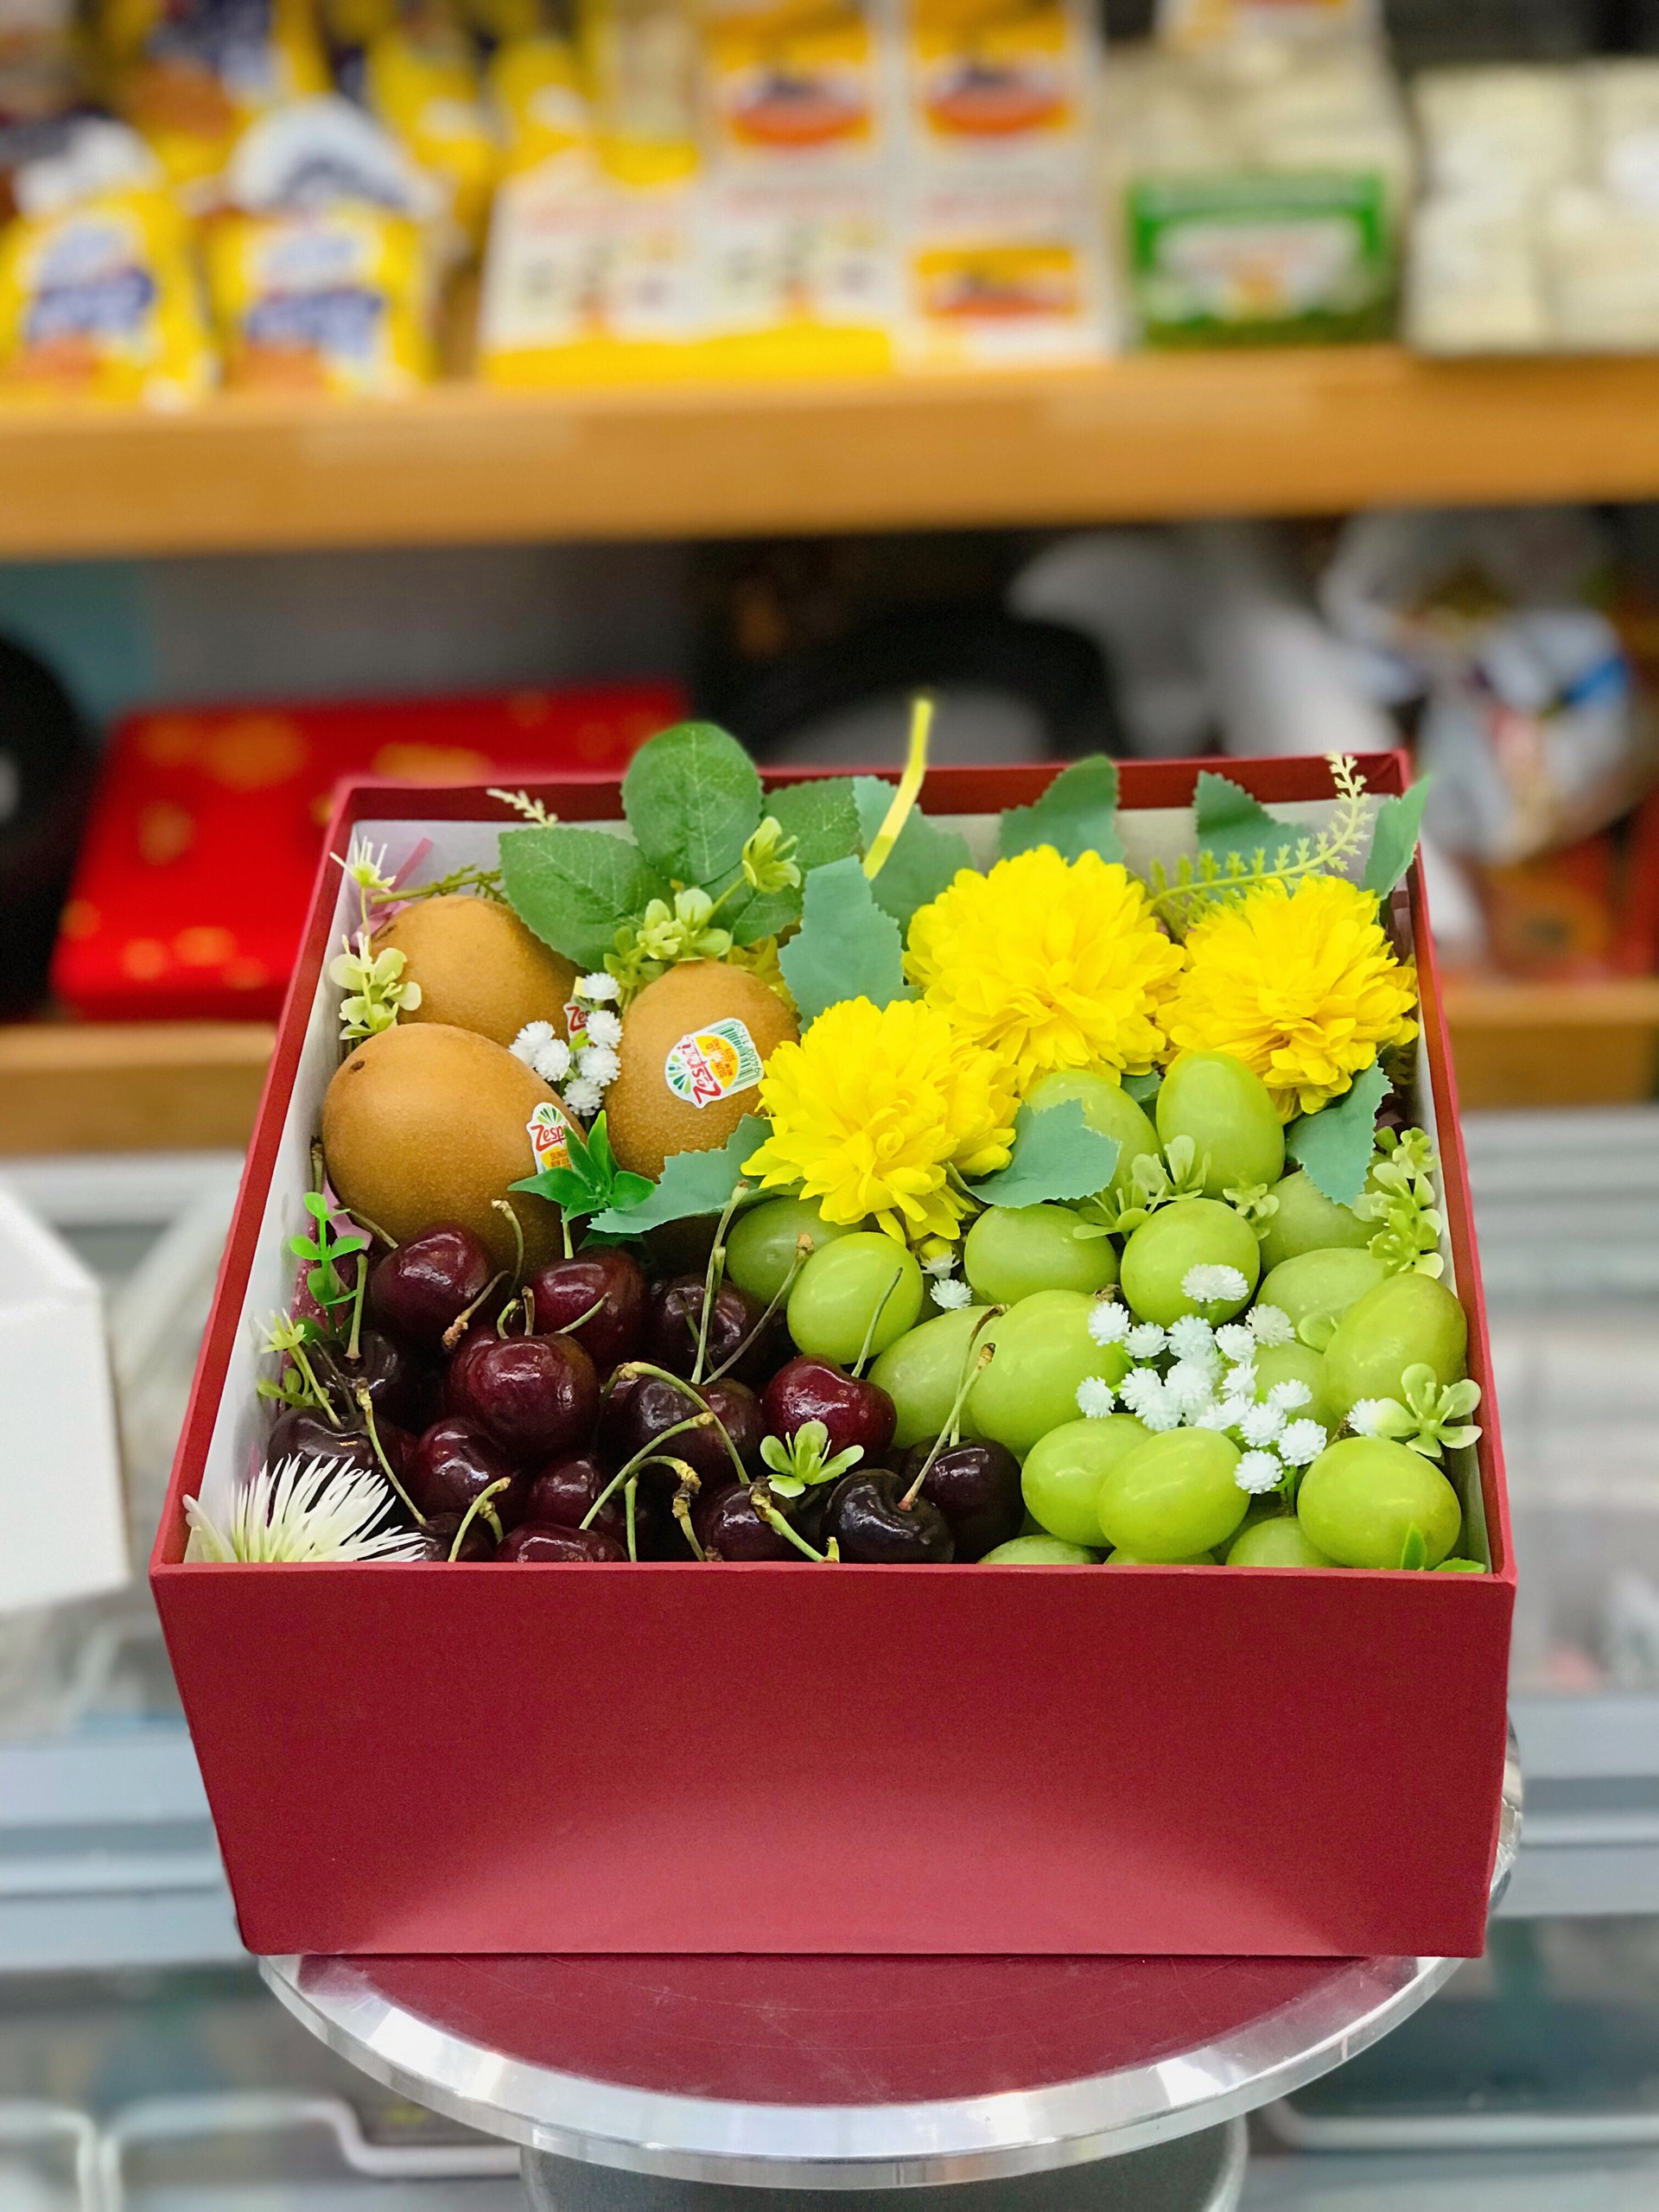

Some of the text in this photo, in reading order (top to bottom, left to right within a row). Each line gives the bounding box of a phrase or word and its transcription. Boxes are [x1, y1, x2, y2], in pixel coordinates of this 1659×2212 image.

[567, 1006, 591, 1032] Zes
[677, 1039, 721, 1103] Zespri
[706, 1042, 727, 1078] SUNLD
[530, 1124, 566, 1152] Zesp
